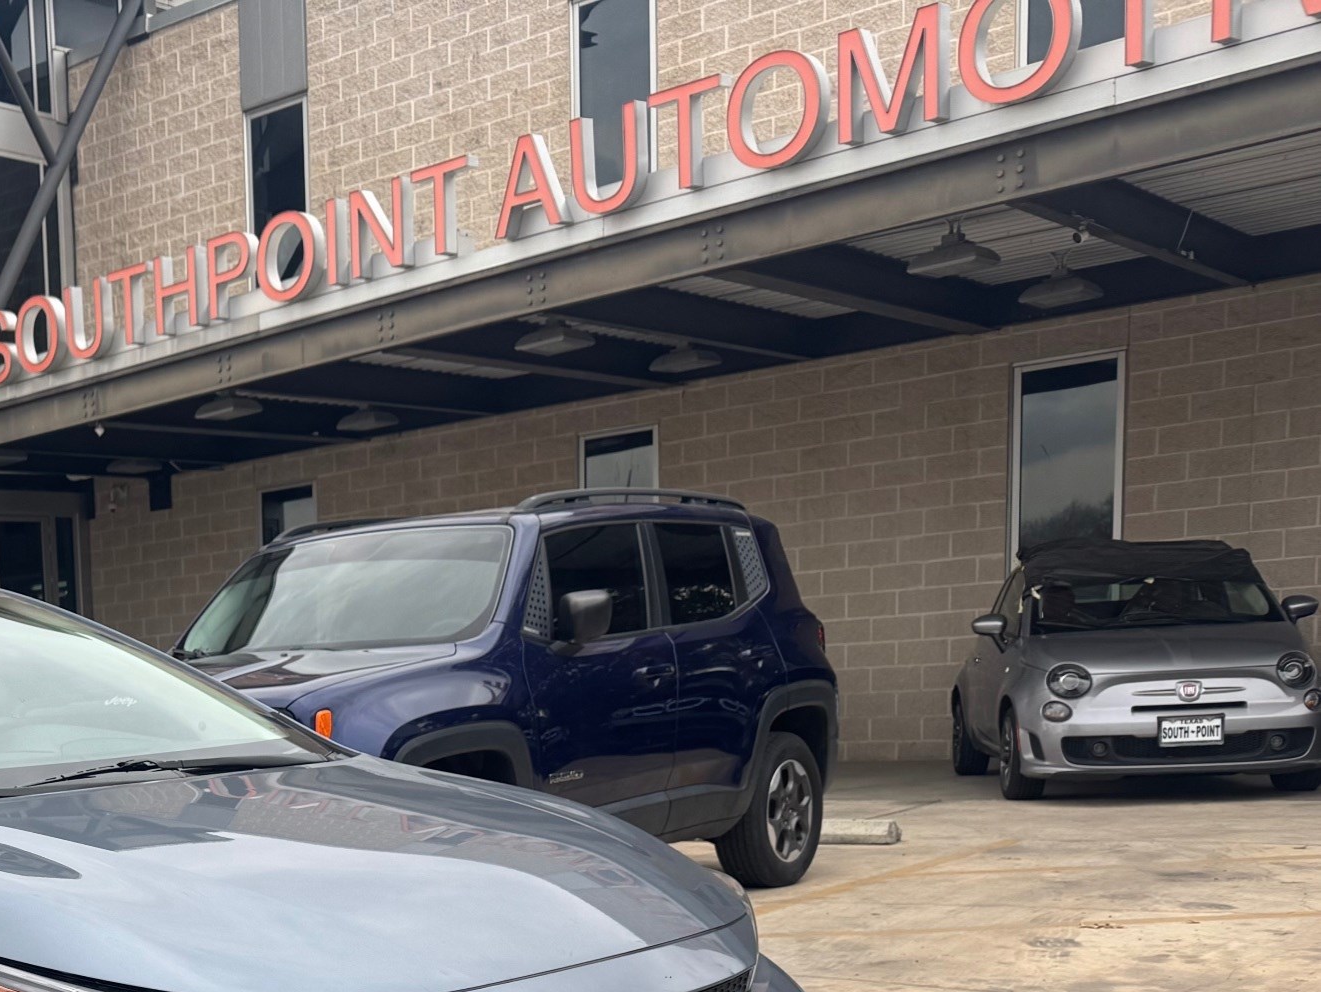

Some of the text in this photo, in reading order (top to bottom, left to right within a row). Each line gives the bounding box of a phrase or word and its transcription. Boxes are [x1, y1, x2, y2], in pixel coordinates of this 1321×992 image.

[495, 0, 1321, 240] AUTOMO
[1162, 724, 1221, 739] SOUTH POINT
